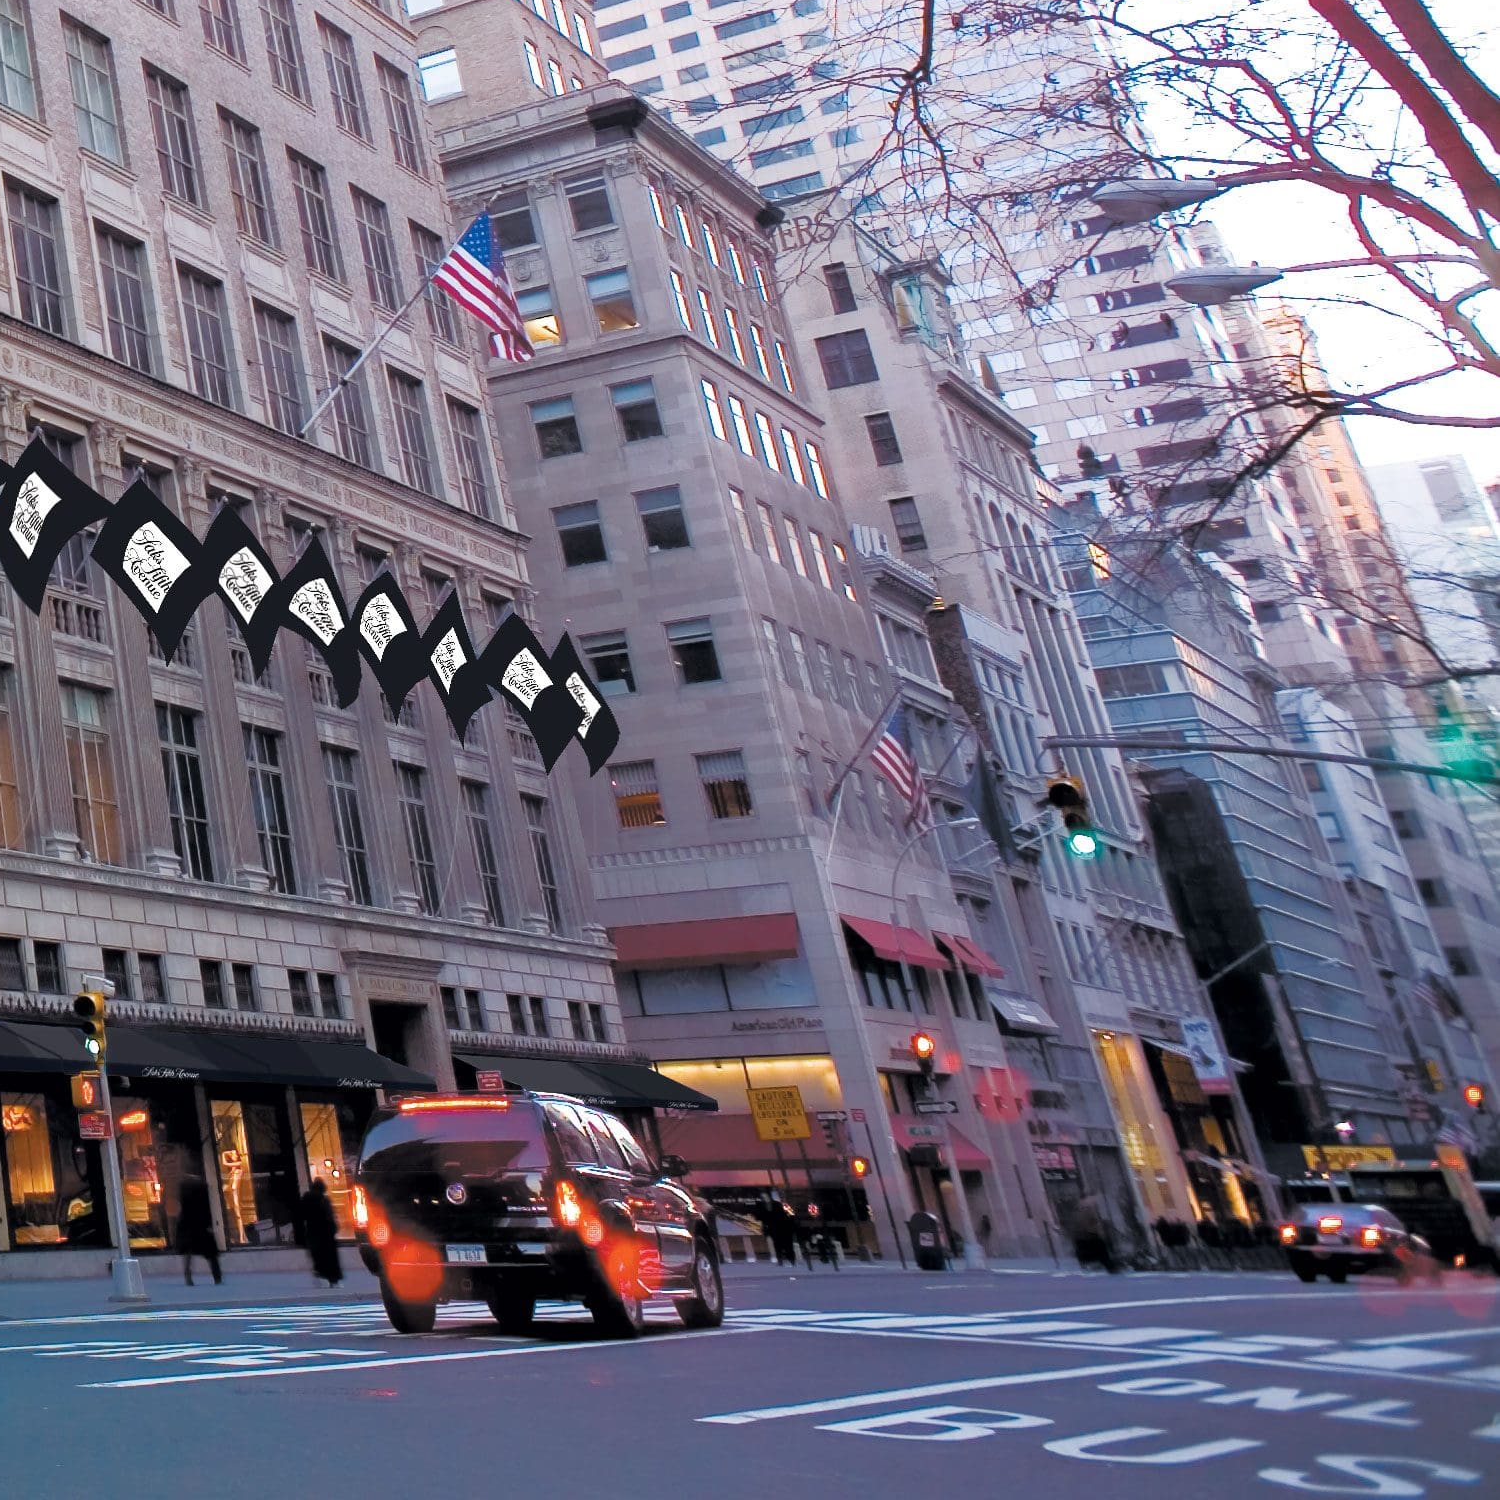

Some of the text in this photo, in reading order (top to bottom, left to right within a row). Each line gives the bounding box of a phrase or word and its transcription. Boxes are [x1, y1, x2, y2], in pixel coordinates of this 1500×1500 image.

[132, 529, 164, 565] Saks
[229, 553, 257, 581] Saks
[124, 548, 160, 599] Avenue
[140, 557, 172, 593] Fifth
[220, 567, 252, 612] Avenue
[1097, 1377, 1500, 1438] ONL
[814, 1405, 1482, 1496] BUS
